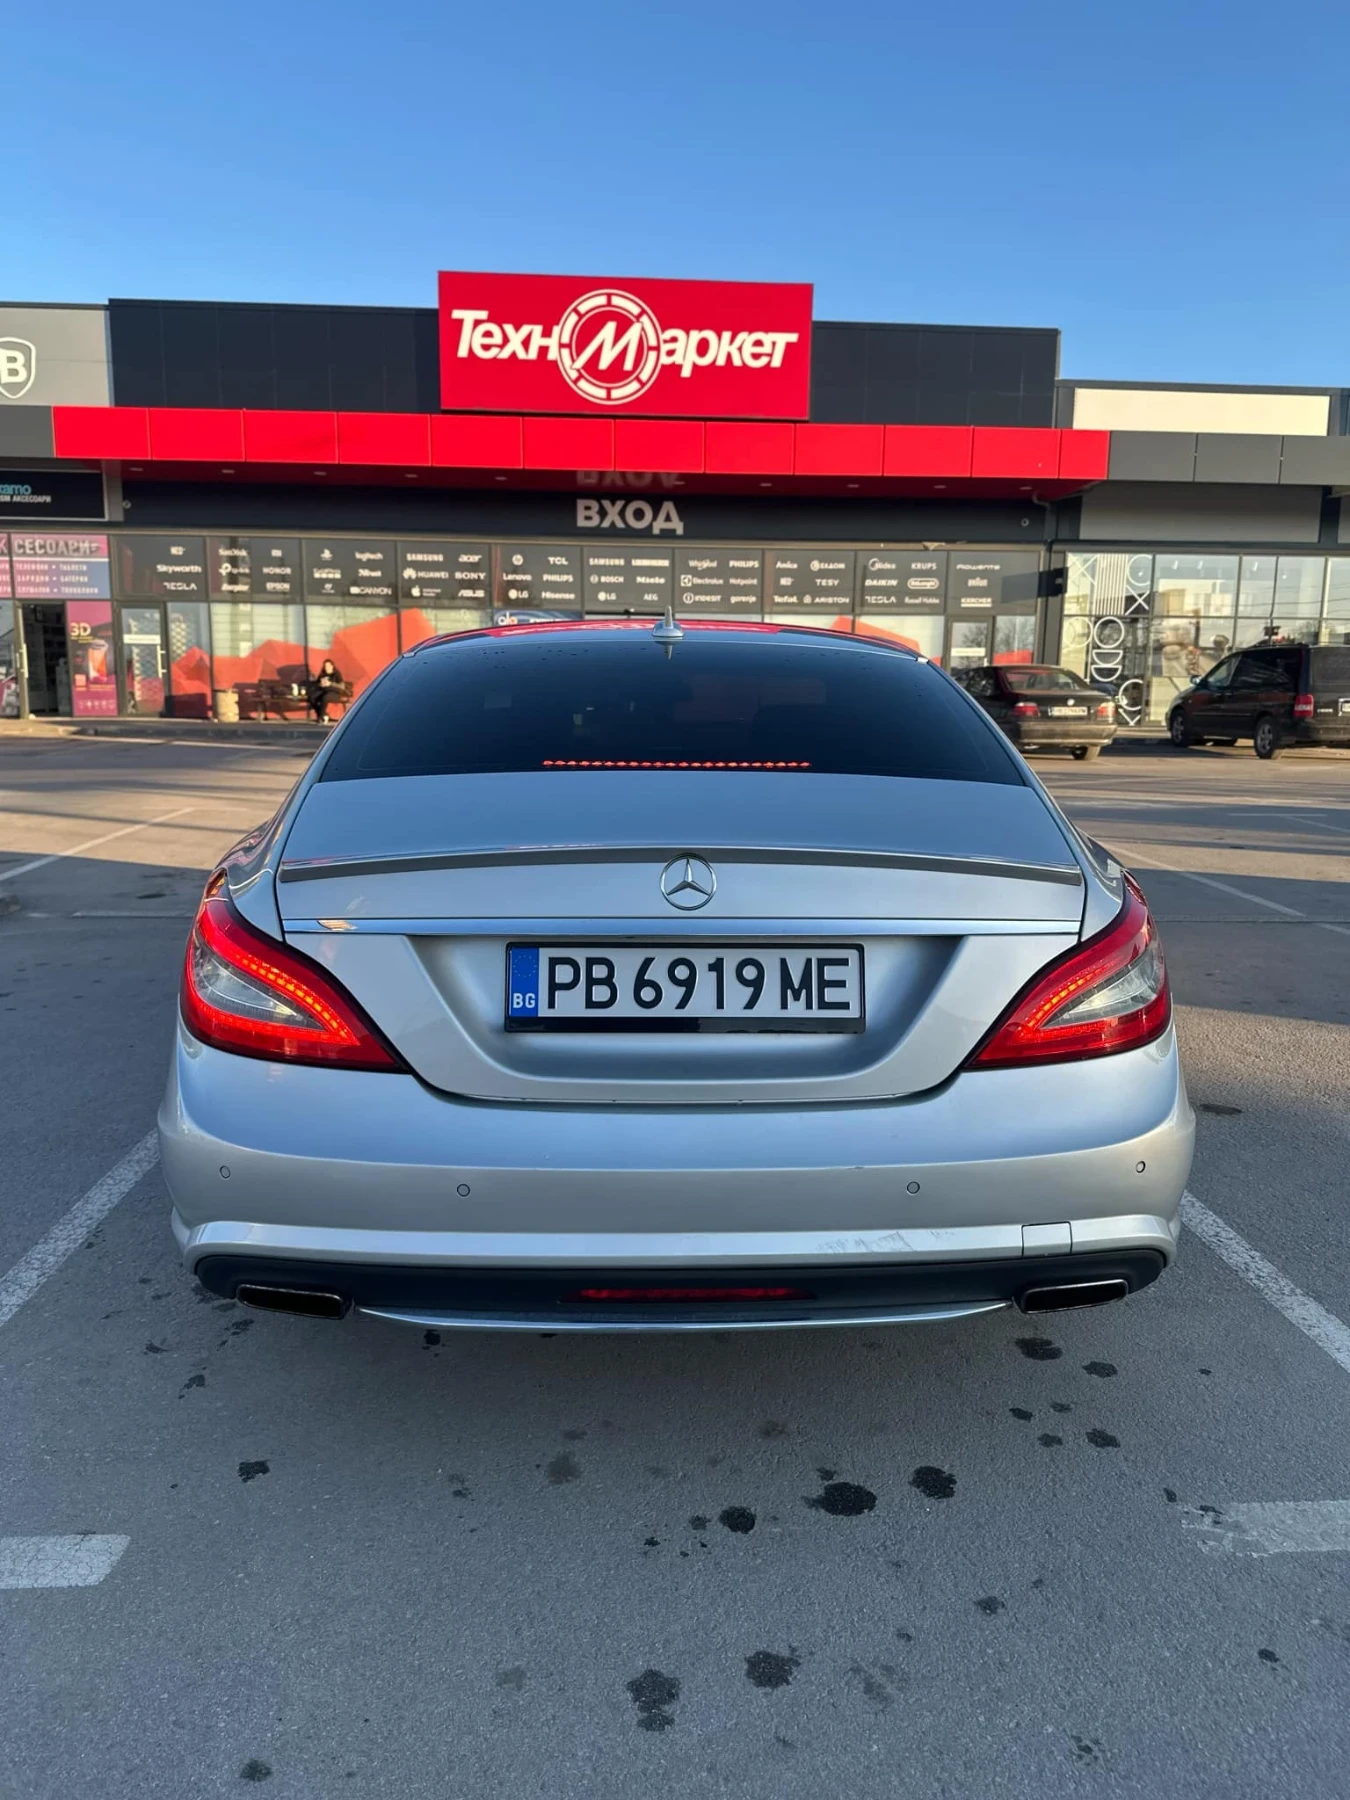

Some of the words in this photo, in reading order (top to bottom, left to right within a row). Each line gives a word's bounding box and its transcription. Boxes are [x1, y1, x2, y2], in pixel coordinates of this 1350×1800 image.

[12, 495, 52, 503] АКСЕСОАРИ
[576, 499, 684, 536] ВХОД
[406, 553, 444, 562] SAMSUNG
[458, 554, 482, 563] acer
[547, 556, 569, 565] TCL
[588, 557, 625, 566] SAMSUNG
[156, 564, 202, 574] Skyworth
[728, 560, 760, 569] PHILIPS
[911, 562, 937, 570] KRUPS
[262, 566, 292, 575] HONOR
[417, 571, 449, 579] HUAWEI
[454, 571, 486, 580] SONY
[502, 572, 533, 581] Lenovo
[542, 573, 574, 583] PHILIPS
[600, 575, 625, 583] BOSCH
[692, 576, 724, 585] Electrolux
[729, 578, 758, 586] Hotpoint
[815, 578, 840, 587] TESY
[864, 578, 898, 587] DAIKIN
[163, 581, 198, 591] TESLA
[265, 581, 291, 592] EPSON
[358, 586, 392, 595] CANYON
[457, 589, 485, 598] ASUS
[517, 590, 529, 599] LG
[541, 591, 576, 600] Hisense
[606, 592, 617, 601] LG
[643, 593, 659, 601] AEG
[694, 594, 722, 602] INDESIT
[729, 595, 757, 604] gorenje
[773, 595, 798, 603] Tefal
[864, 595, 897, 604] TESLA
[70, 622, 92, 637] 3D
[547, 956, 619, 1010] PB
[632, 956, 766, 1010] 6919
[780, 956, 851, 1011] ME
[512, 992, 536, 1009] BG
